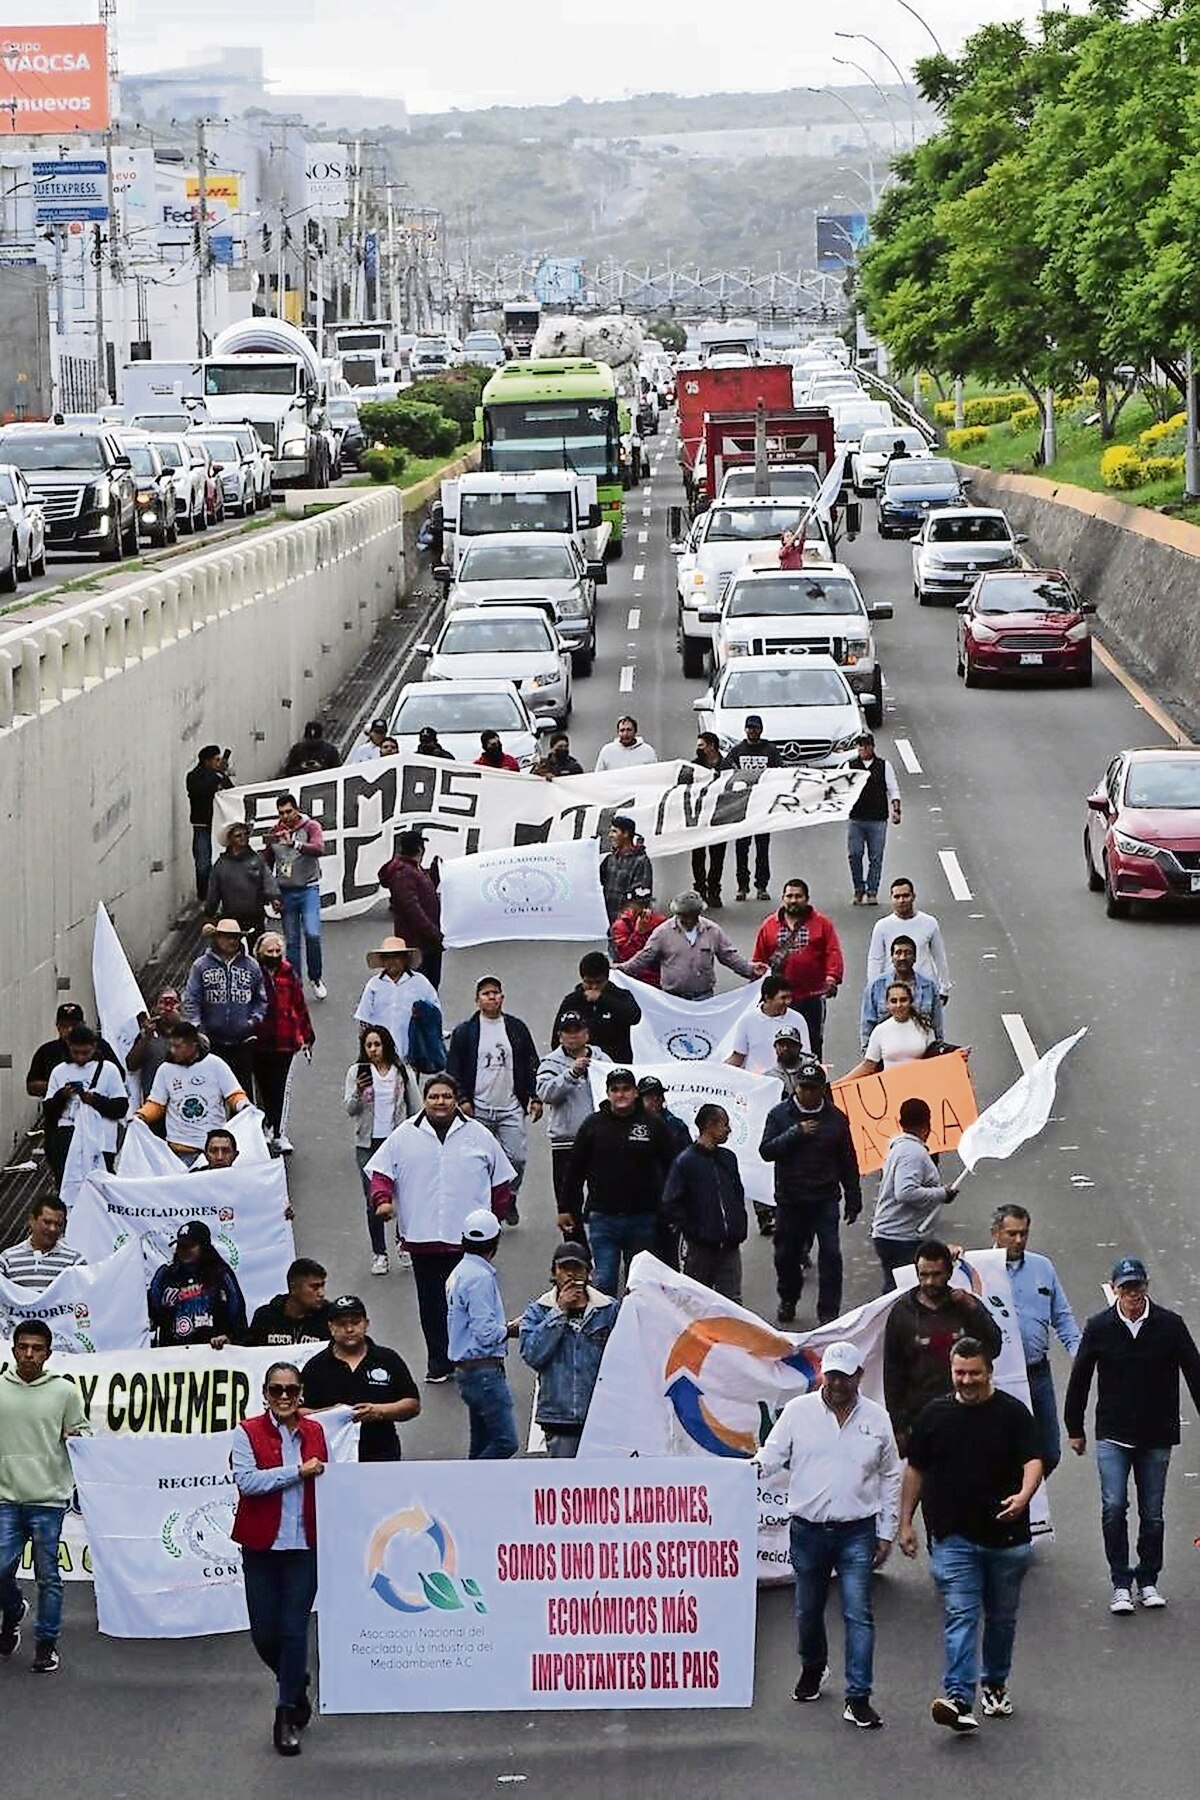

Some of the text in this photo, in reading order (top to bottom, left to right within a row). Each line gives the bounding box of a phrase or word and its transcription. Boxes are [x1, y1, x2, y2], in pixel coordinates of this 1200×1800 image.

[4, 53, 91, 74] VAQCSA
[163, 206, 217, 222] FedEx
[832, 1075, 888, 1120] TU
[107, 1203, 218, 1218] RECICLADORES
[107, 1369, 250, 1434] CONIMER
[158, 1474, 238, 1490] RECICLA
[534, 1485, 712, 1526] NO SOMOS LADRONES,
[498, 1539, 740, 1580] SOMOS UNO DE LOS SECTORES
[548, 1589, 698, 1635] ECONÓMICOS MÁS
[532, 1650, 720, 1691] IMPORTANTES DEL PAIS
